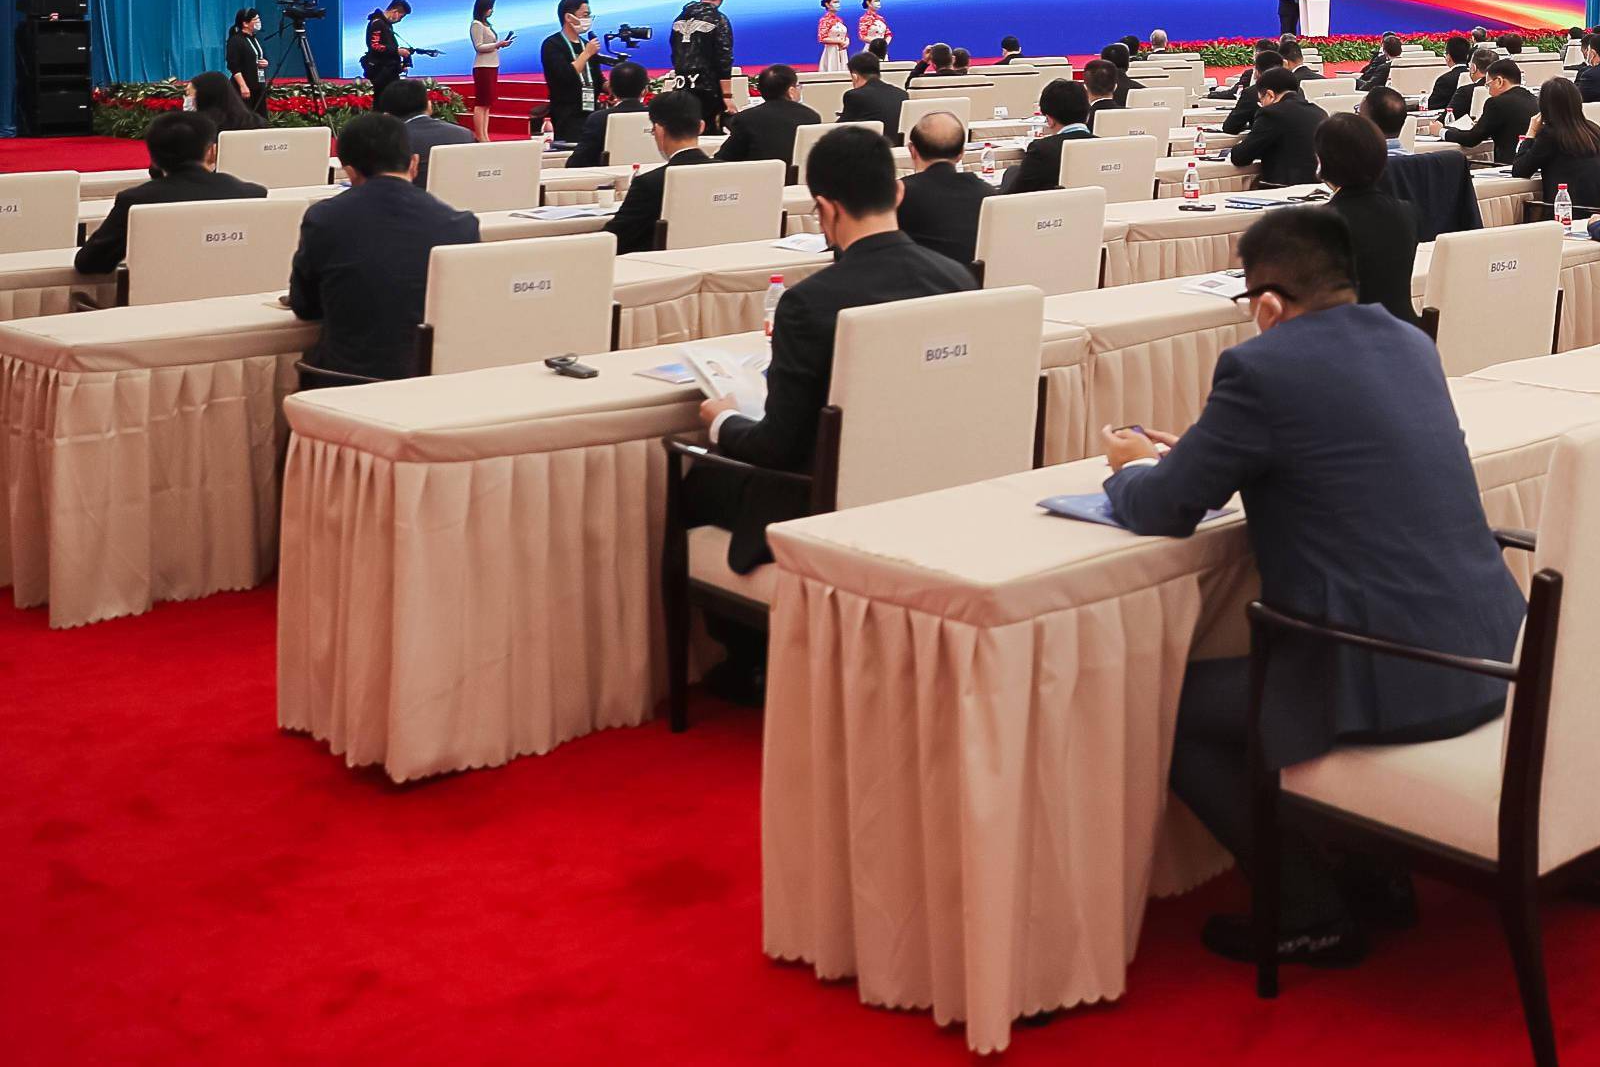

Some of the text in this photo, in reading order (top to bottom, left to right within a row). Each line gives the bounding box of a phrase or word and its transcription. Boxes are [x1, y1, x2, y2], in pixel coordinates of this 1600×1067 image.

[1036, 218, 1063, 230] B04-02
[205, 231, 244, 243] B03-01
[1490, 259, 1518, 273] B05-02
[513, 279, 552, 294] B04-01
[925, 343, 968, 362] B05-01
